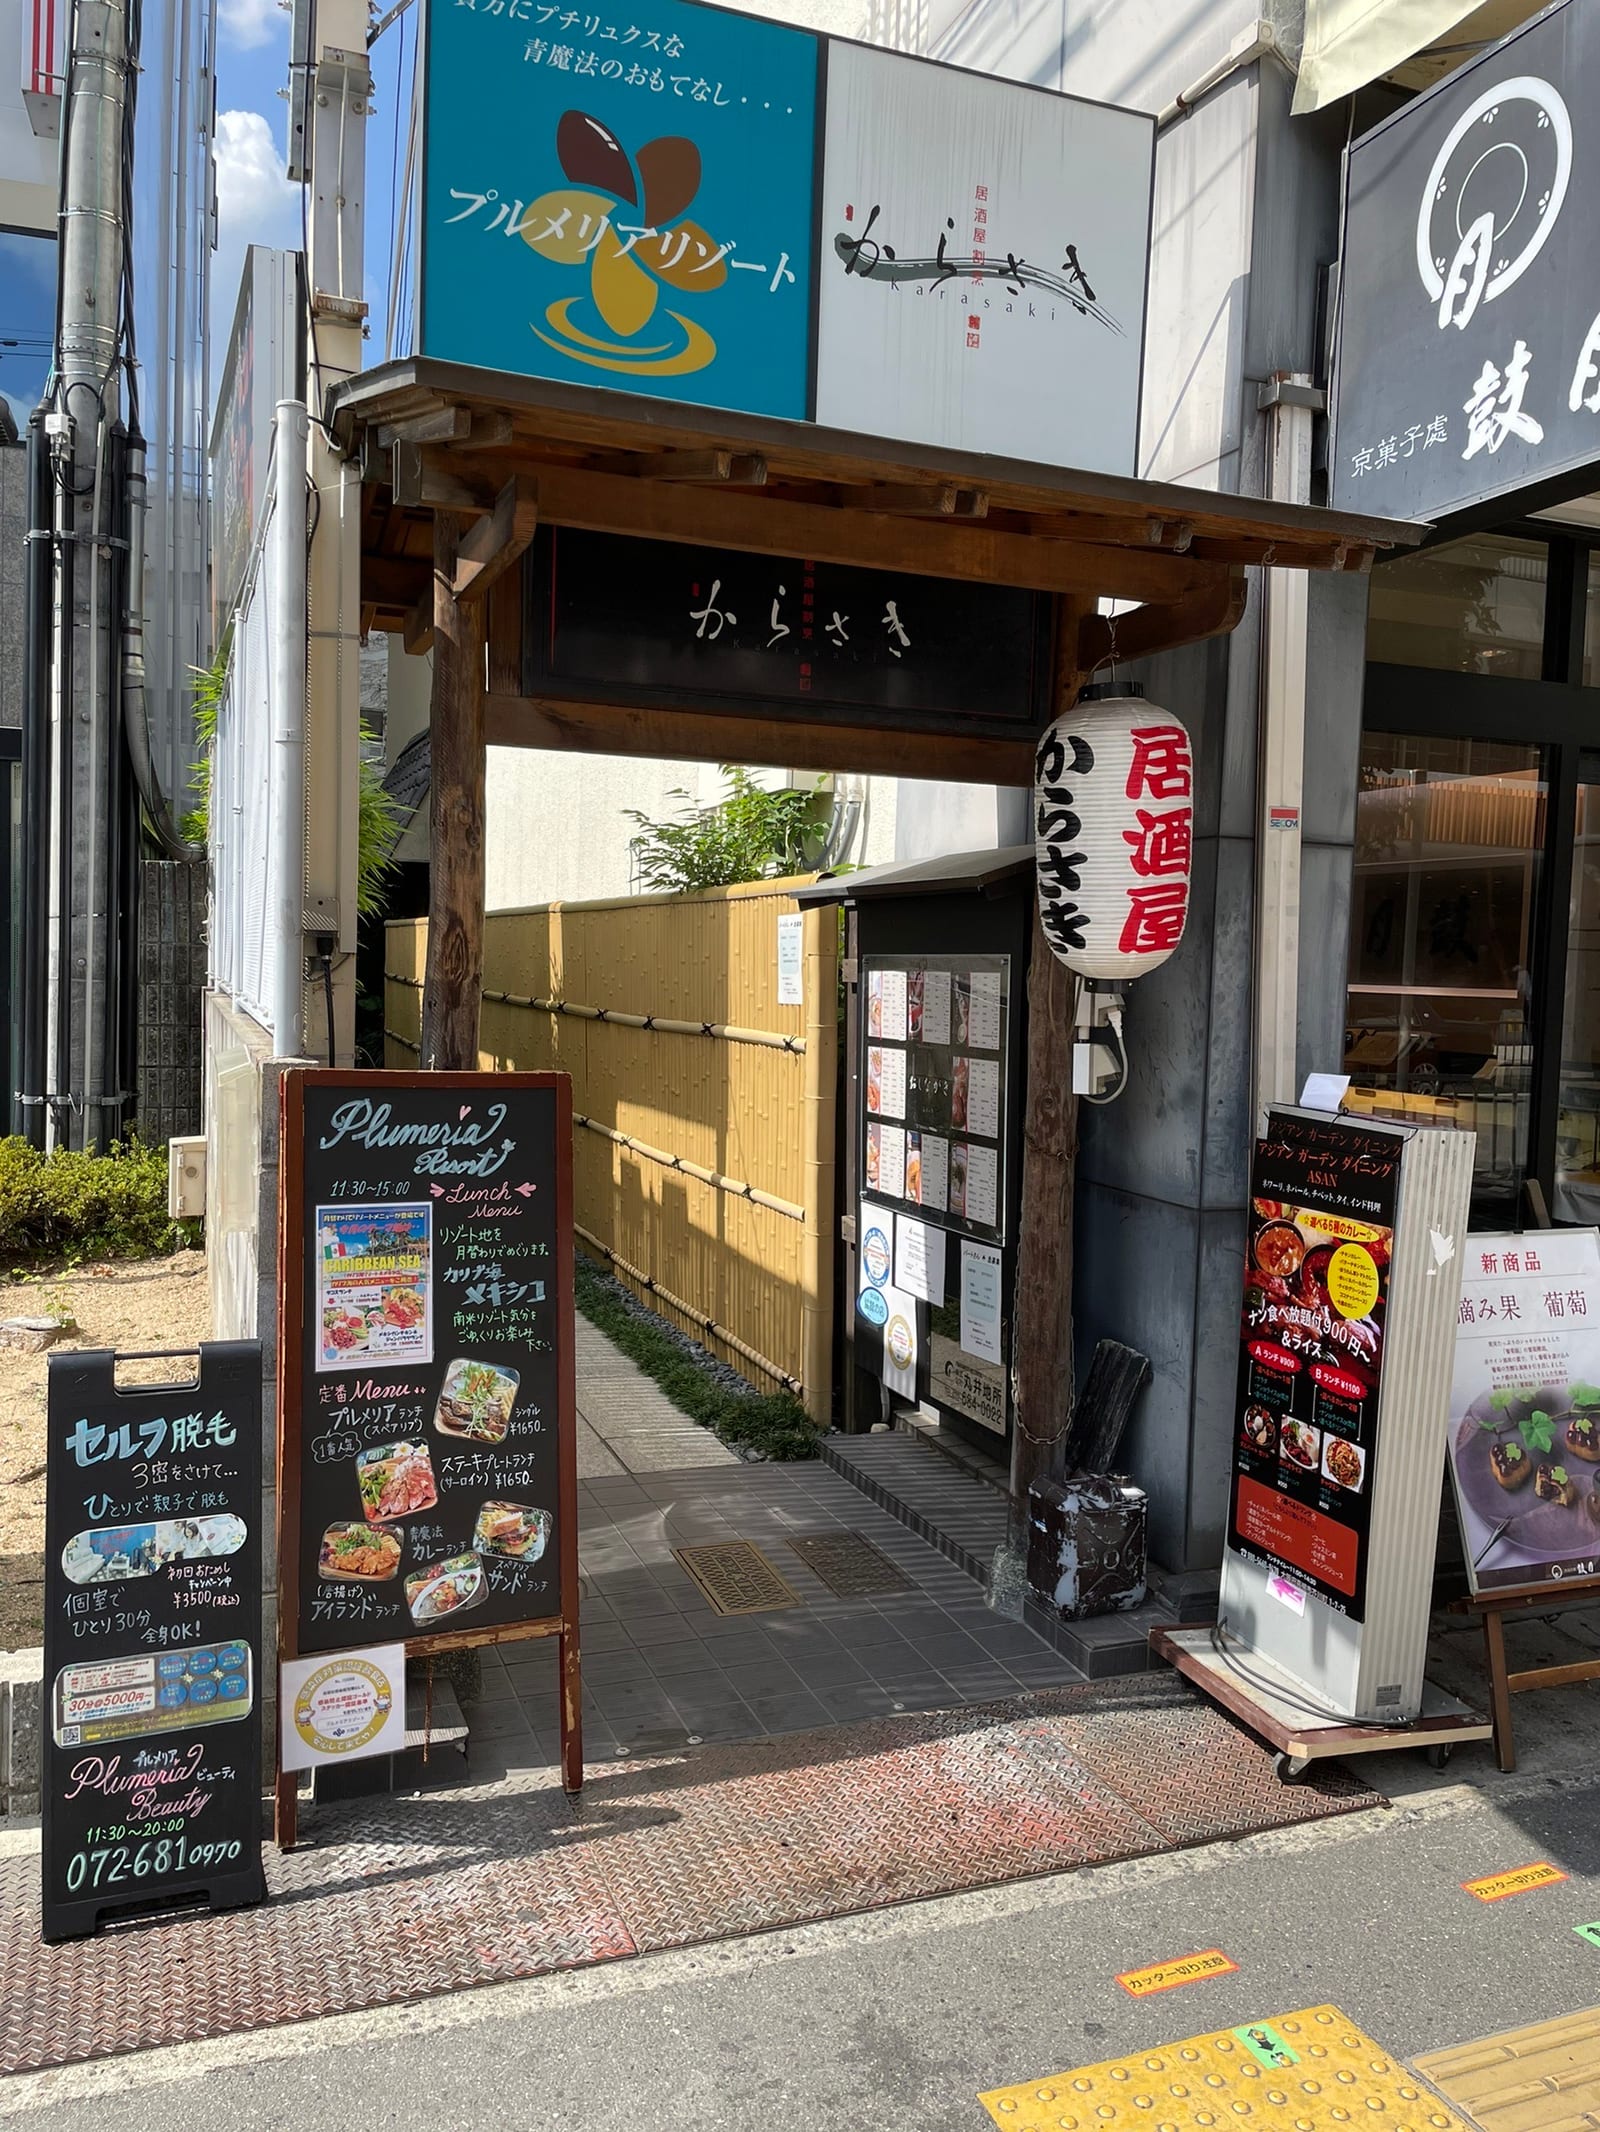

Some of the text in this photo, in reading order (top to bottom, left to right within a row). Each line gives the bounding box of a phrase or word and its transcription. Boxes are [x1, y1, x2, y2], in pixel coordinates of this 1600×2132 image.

[443, 188, 796, 293] プルメリアリゾート
[840, 205, 1097, 315] からさき
[690, 579, 911, 658] からさき
[1035, 728, 1095, 954] からさき
[1118, 725, 1193, 953] 居酒屋
[320, 1098, 507, 1149] Plumeria
[445, 1182, 512, 1201] Lunch
[1306, 1169, 1339, 1188] ASAN
[468, 1204, 522, 1219] Menu
[440, 1225, 502, 1246] リゾート地を
[324, 1255, 421, 1273] CARIBBEAN SEA
[1481, 1251, 1541, 1274] 新商品
[461, 1280, 547, 1307] メキシコ
[1543, 1289, 1588, 1318] 葡萄
[1255, 1346, 1261, 1356] A
[1315, 1368, 1322, 1379] B
[318, 1379, 410, 1405] 定番 Menu
[963, 1373, 1002, 1406] 丸井地所
[65, 1410, 237, 1467] セルフ脱毛
[63, 1587, 126, 1617] 個室で
[64, 1744, 204, 1800] Plumeria
[133, 1749, 177, 1768] プルメリア
[127, 1786, 212, 1822] Beauty
[1475, 1866, 1558, 1897] カッター切り注意
[1128, 1956, 1227, 1990] カッター切り注意
